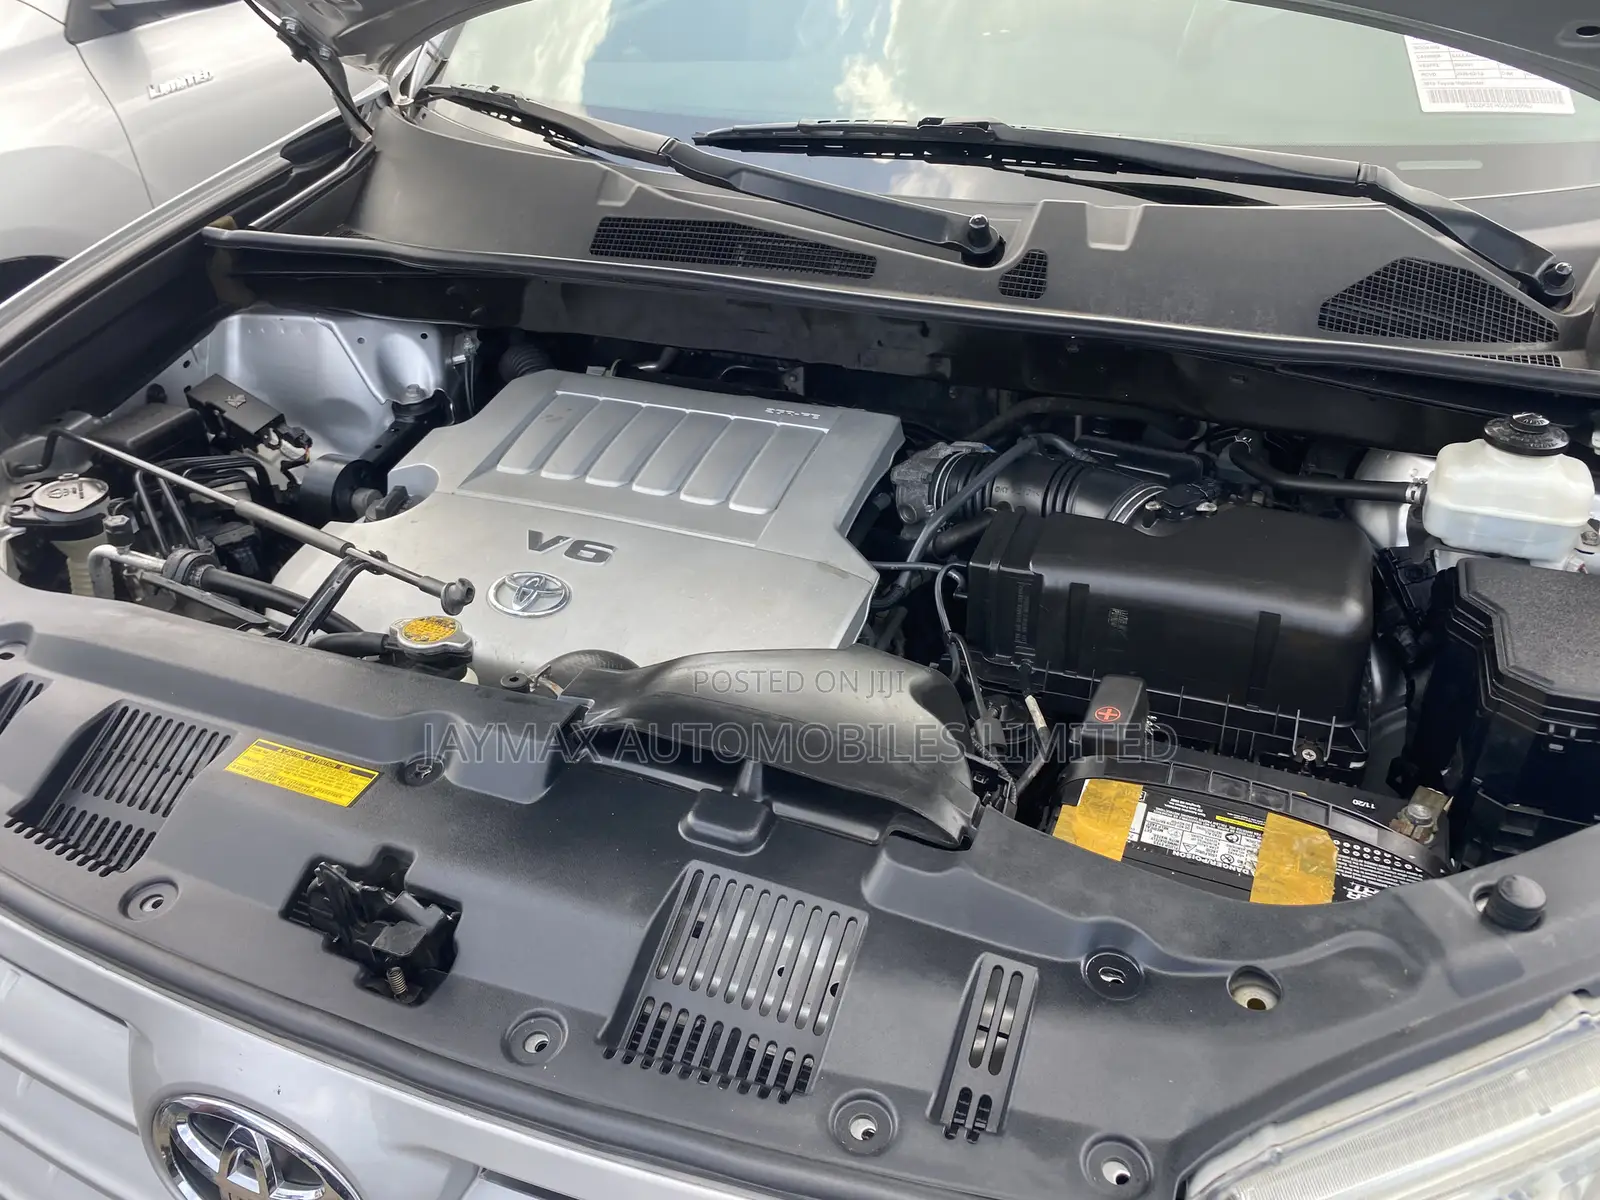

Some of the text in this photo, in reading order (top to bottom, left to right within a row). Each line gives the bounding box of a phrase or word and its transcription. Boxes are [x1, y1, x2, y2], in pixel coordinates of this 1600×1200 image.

[527, 528, 618, 566] V6
[1352, 799, 1376, 810] 11/20
[1172, 850, 1250, 875] DANGER/POISON
